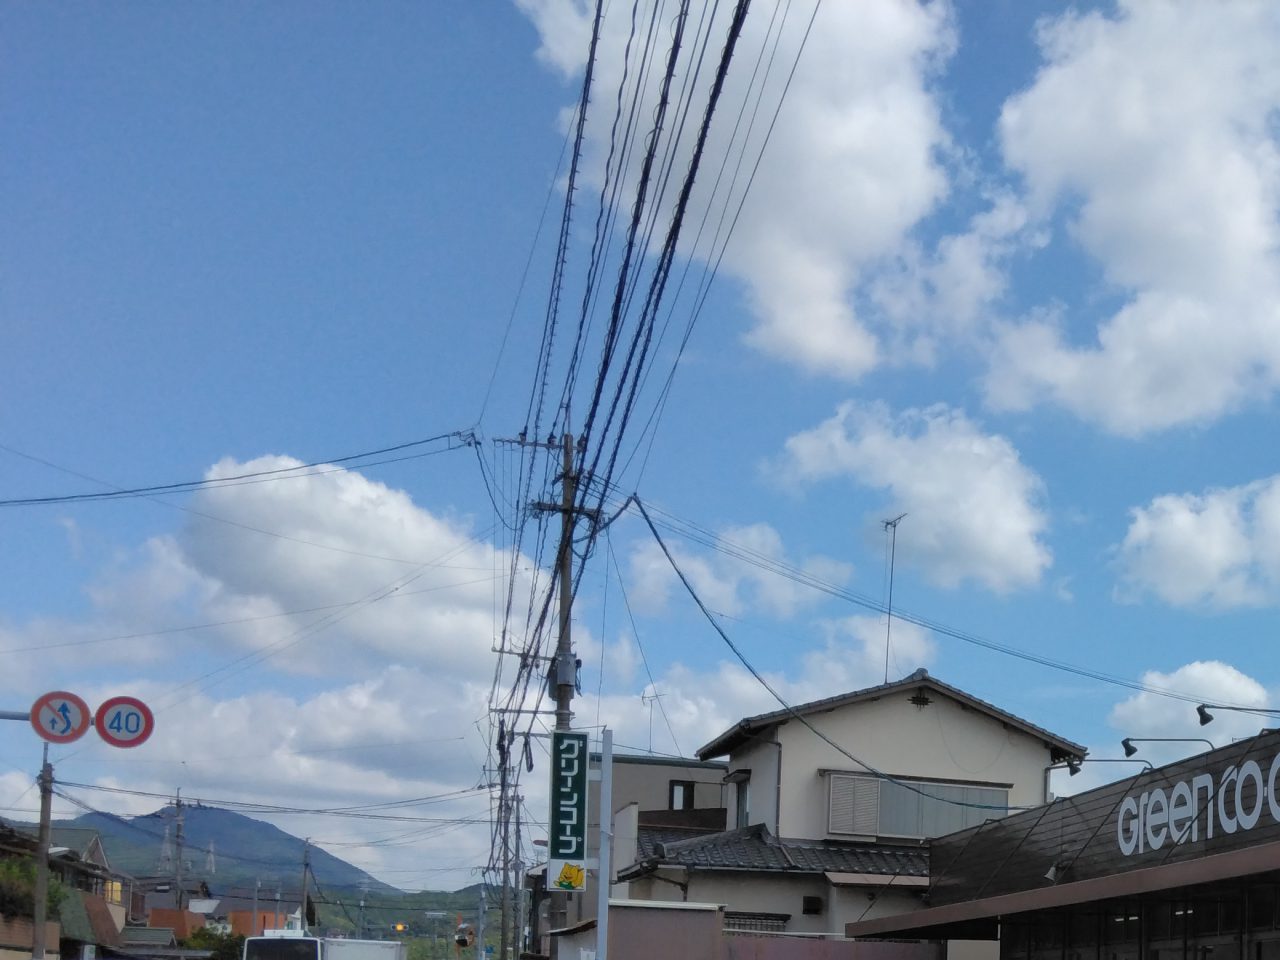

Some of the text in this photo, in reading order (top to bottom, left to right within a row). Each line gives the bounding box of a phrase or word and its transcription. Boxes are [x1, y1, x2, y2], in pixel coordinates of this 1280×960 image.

[108, 710, 141, 734] 40
[559, 738, 584, 854] グリーンコープ
[1117, 772, 1214, 856] Green
